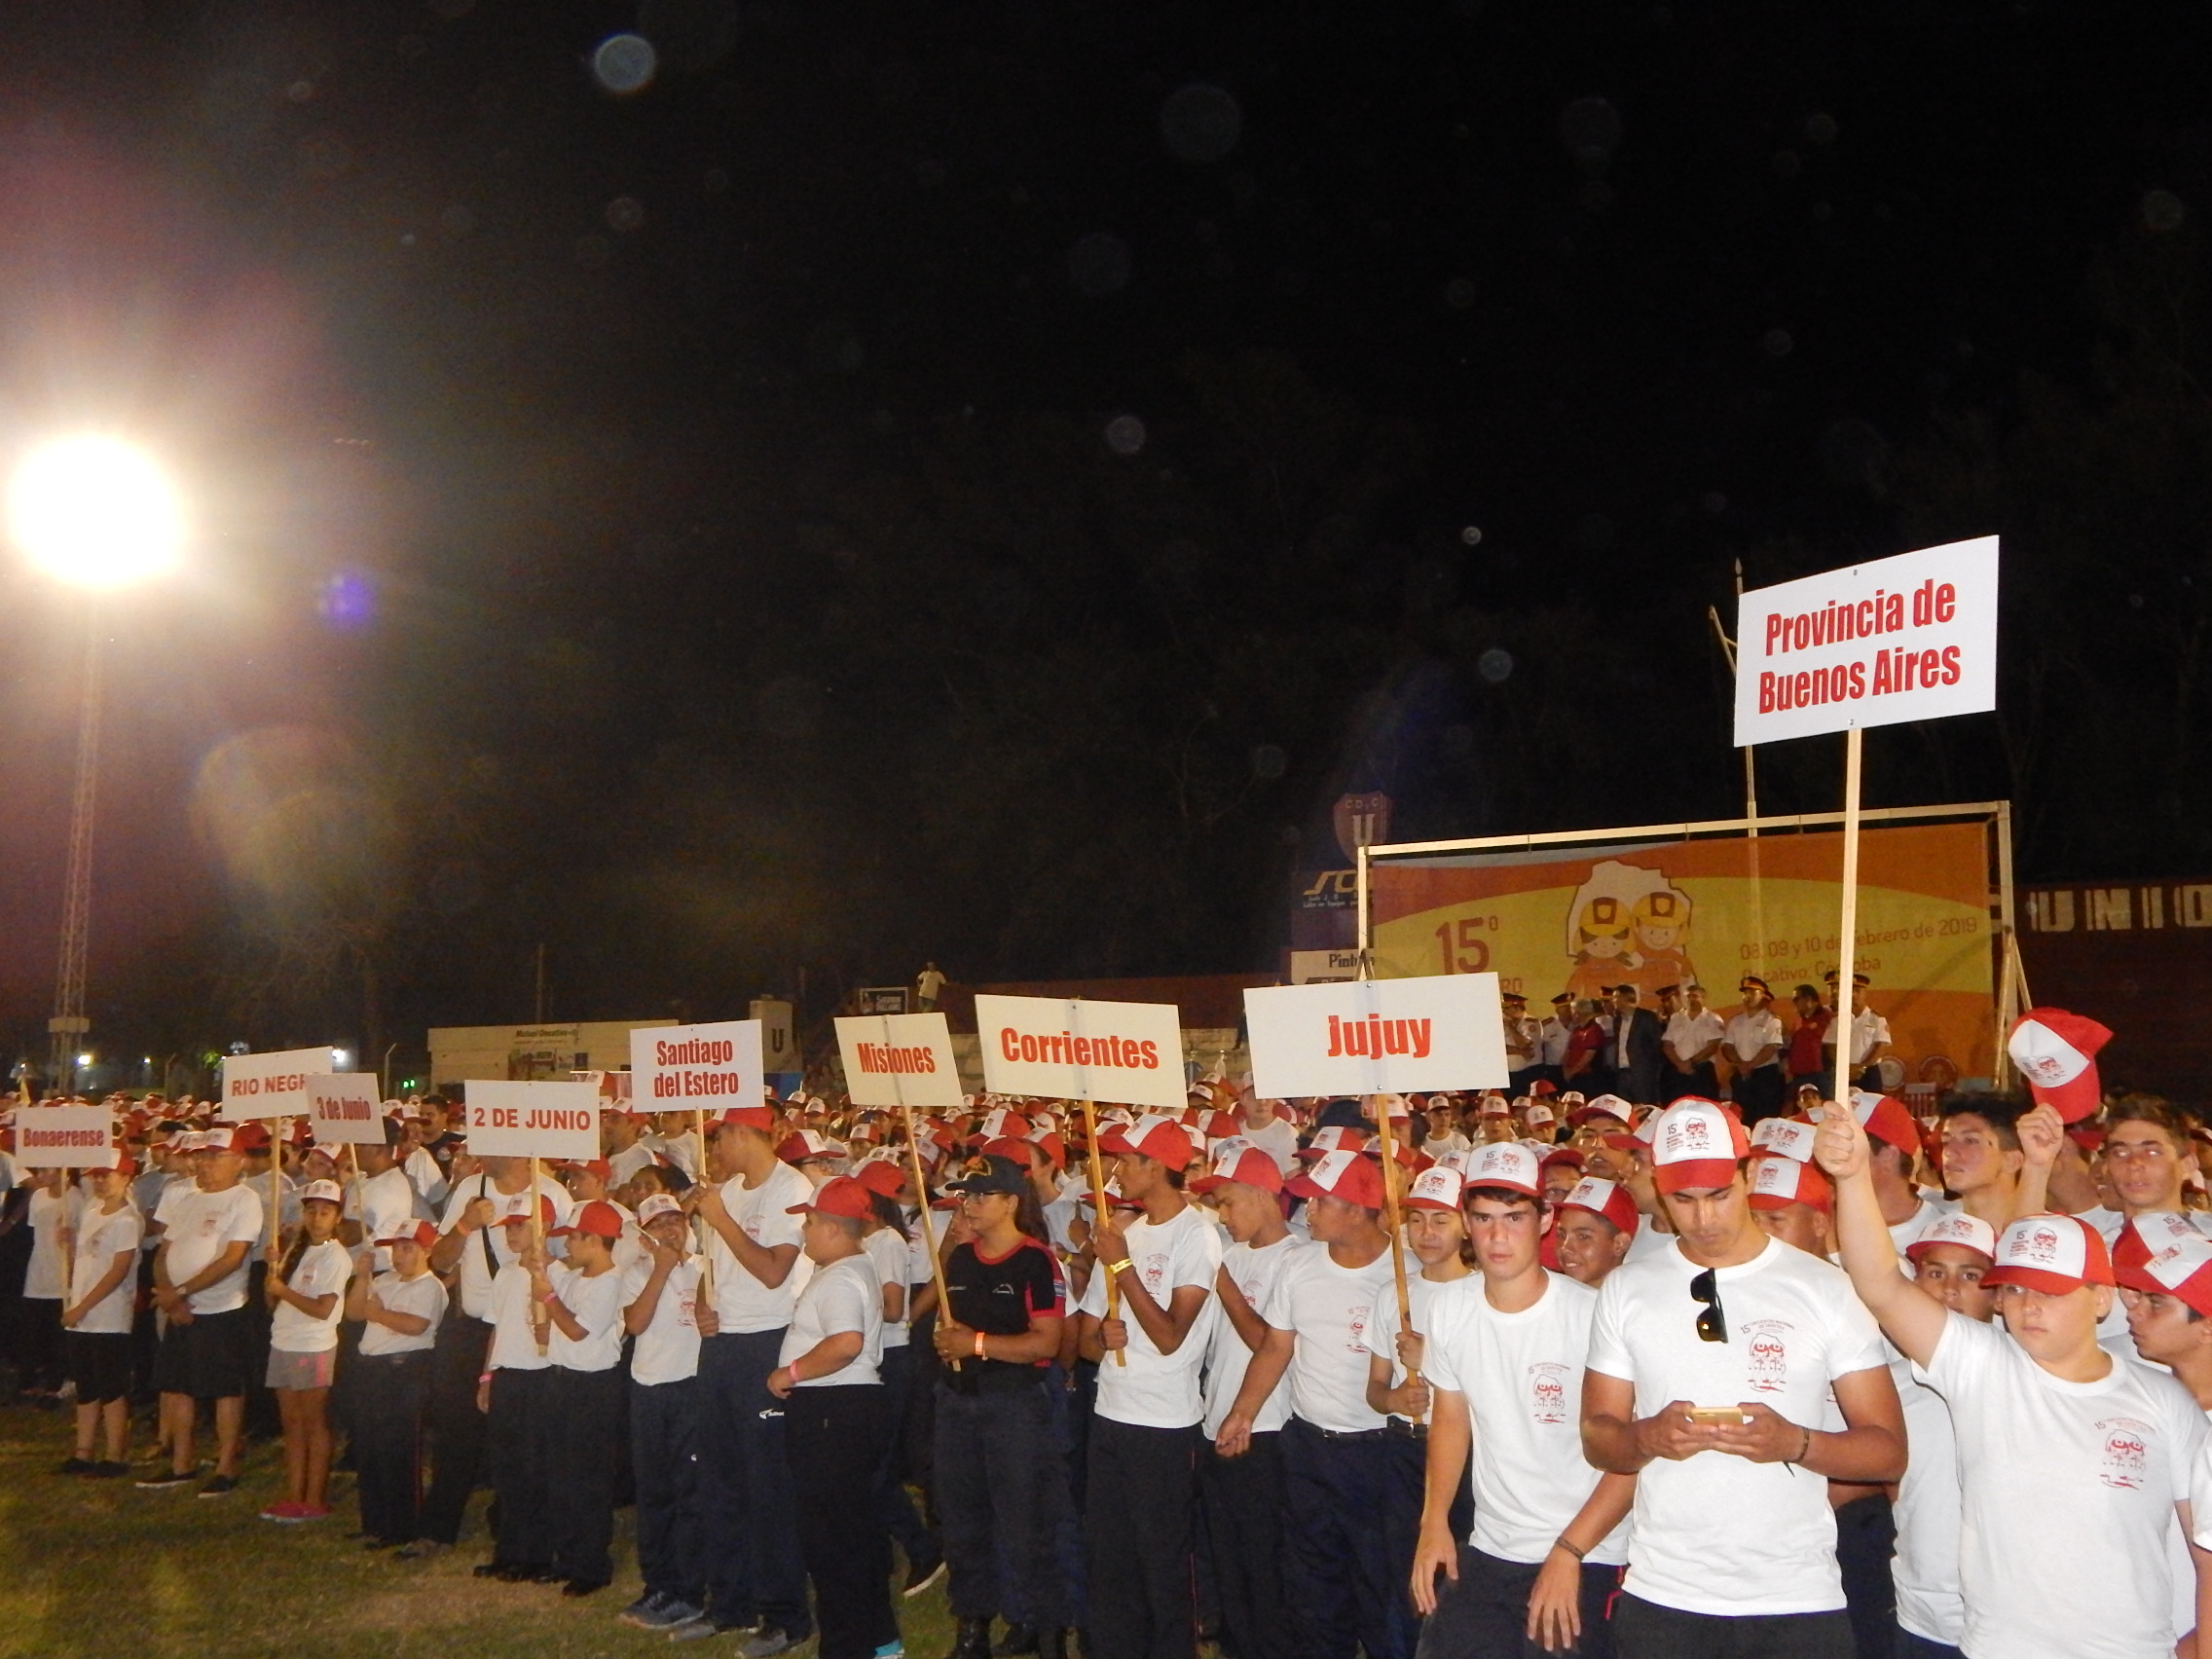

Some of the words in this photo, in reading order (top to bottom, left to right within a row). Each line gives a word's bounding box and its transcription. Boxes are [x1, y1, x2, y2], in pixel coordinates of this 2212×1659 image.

[1766, 589, 1904, 656] Provincia
[1913, 578, 1956, 627] de
[1759, 661, 1865, 715] Buenos
[1872, 645, 1961, 696] Aires
[1768, 940, 1789, 957] 09
[1792, 942, 1801, 959] y
[1805, 937, 1821, 952] 10
[1853, 928, 1910, 946] ebrero
[1914, 922, 1935, 939] de
[1938, 916, 1978, 936] 2019
[771, 1028, 785, 1053] U
[1001, 1027, 1159, 1070] Corrientes
[1327, 1014, 1431, 1060] Jujuy
[656, 1038, 733, 1066] Santiago
[857, 1043, 936, 1074] Misiones
[232, 1078, 260, 1097] RIO
[653, 1072, 682, 1098] del
[684, 1071, 739, 1096] Estero
[316, 1096, 325, 1121] 3
[326, 1096, 341, 1121] de
[342, 1096, 371, 1122] Junio
[474, 1107, 486, 1127] 2
[492, 1108, 519, 1128] DE
[525, 1109, 591, 1130] JUNIO
[23, 1127, 104, 1147] Bonaerense
